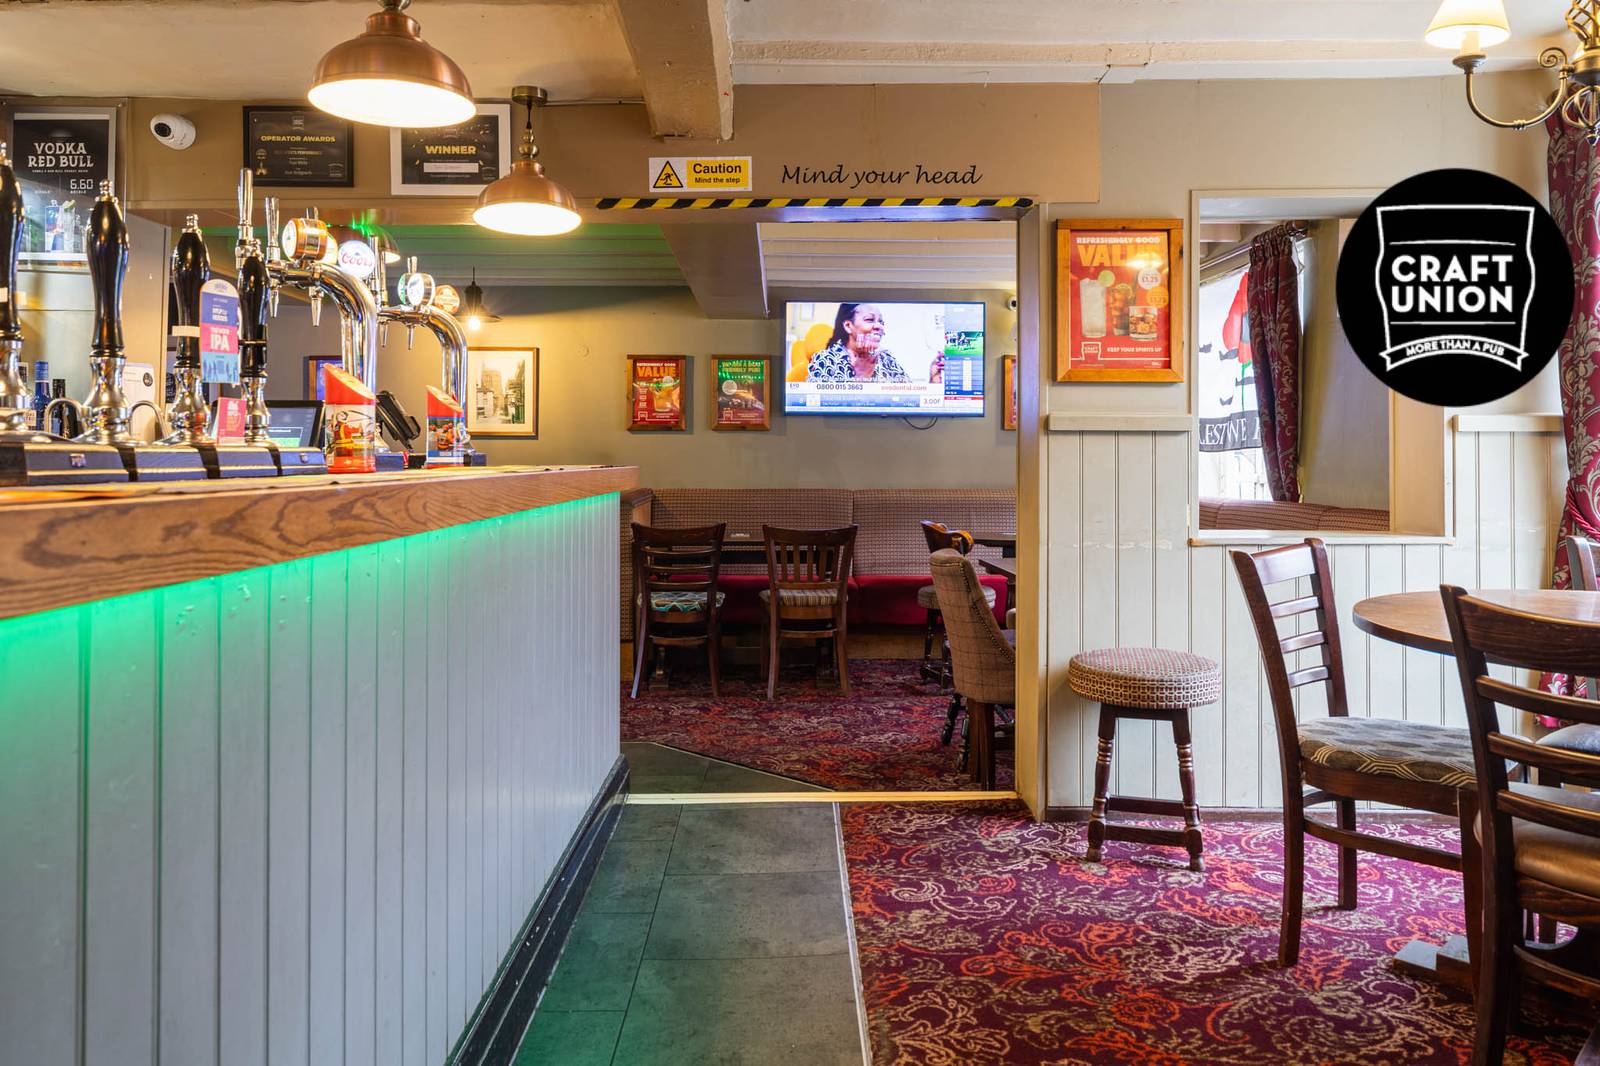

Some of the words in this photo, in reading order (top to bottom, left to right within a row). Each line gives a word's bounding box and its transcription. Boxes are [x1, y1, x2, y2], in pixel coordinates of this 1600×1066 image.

[33, 143, 87, 154] VODKA
[425, 145, 476, 154] WINNER
[28, 156, 56, 167] RED
[60, 156, 94, 167] BULL
[693, 163, 742, 174] Caution
[781, 164, 850, 184] Mind
[850, 169, 910, 189] your
[915, 164, 983, 184] head
[70, 179, 94, 190] 6.60
[1077, 244, 1162, 267] VALU
[211, 334, 230, 351] IPA
[637, 366, 676, 377] VALUE
